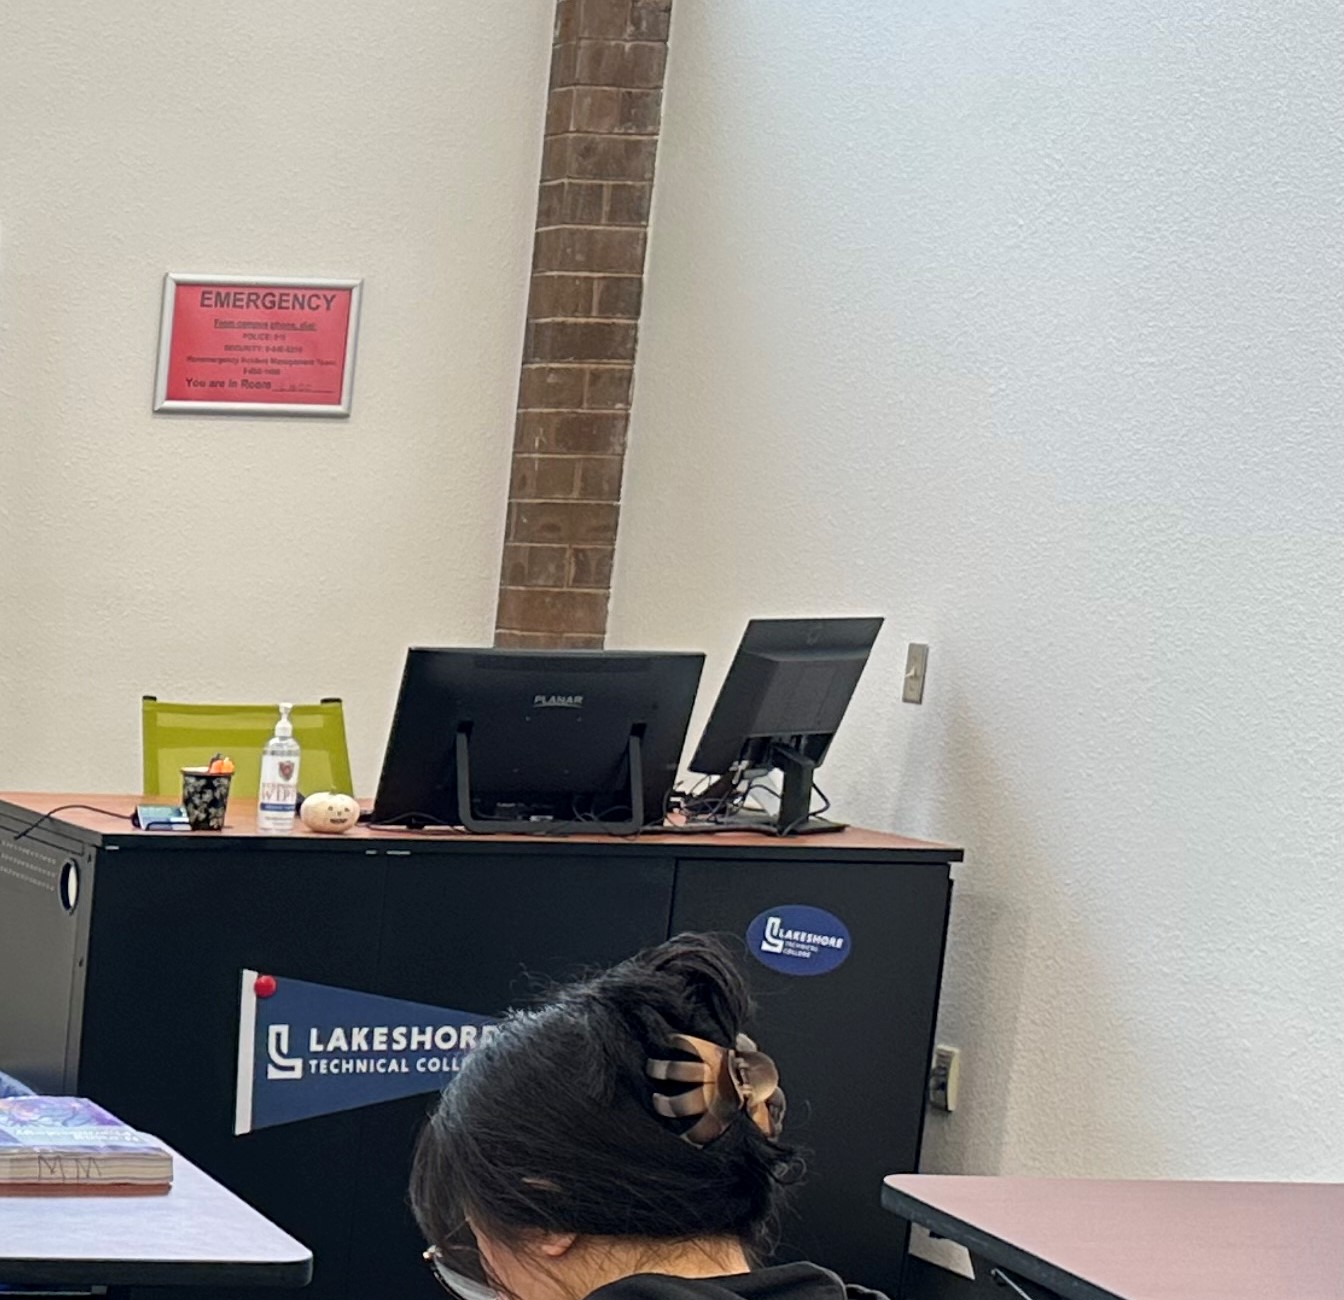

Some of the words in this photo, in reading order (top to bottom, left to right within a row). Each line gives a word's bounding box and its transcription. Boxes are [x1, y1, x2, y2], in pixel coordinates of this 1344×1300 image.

[200, 290, 336, 311] EMERGENCY
[185, 378, 206, 388] You
[209, 380, 225, 388] are
[228, 378, 238, 388] in
[241, 378, 272, 390] Room
[533, 694, 584, 706] PLANAR
[777, 928, 844, 949] LAKESHORE
[309, 1058, 410, 1074] TECHNICAL
[416, 1057, 460, 1072] COLL
